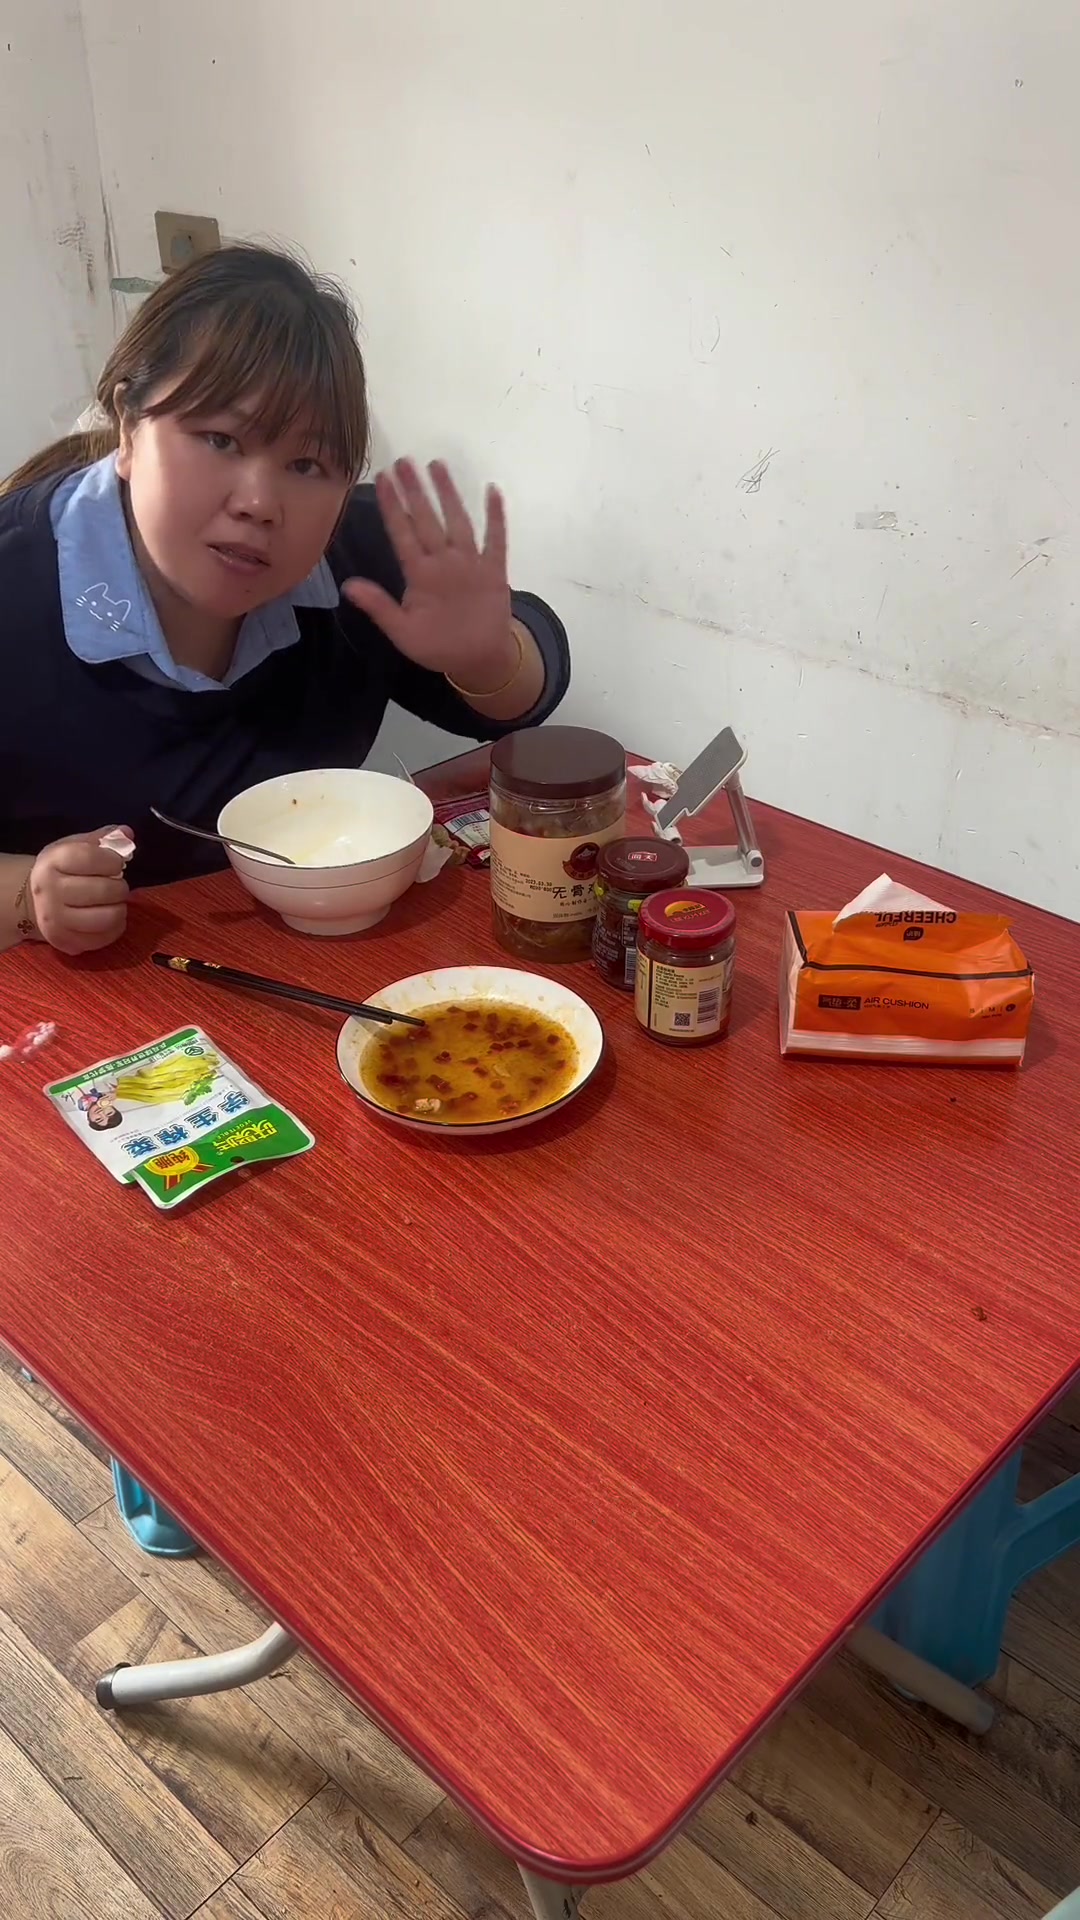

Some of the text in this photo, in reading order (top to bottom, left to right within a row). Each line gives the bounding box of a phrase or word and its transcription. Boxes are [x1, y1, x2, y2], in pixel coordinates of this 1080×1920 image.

[874, 911, 957, 924] CHEERFUL
[864, 997, 880, 1005] AIR
[882, 997, 930, 1010] CUSHION
[122, 1091, 249, 1158] 学生榨菜
[153, 1150, 190, 1169] 纯脆
